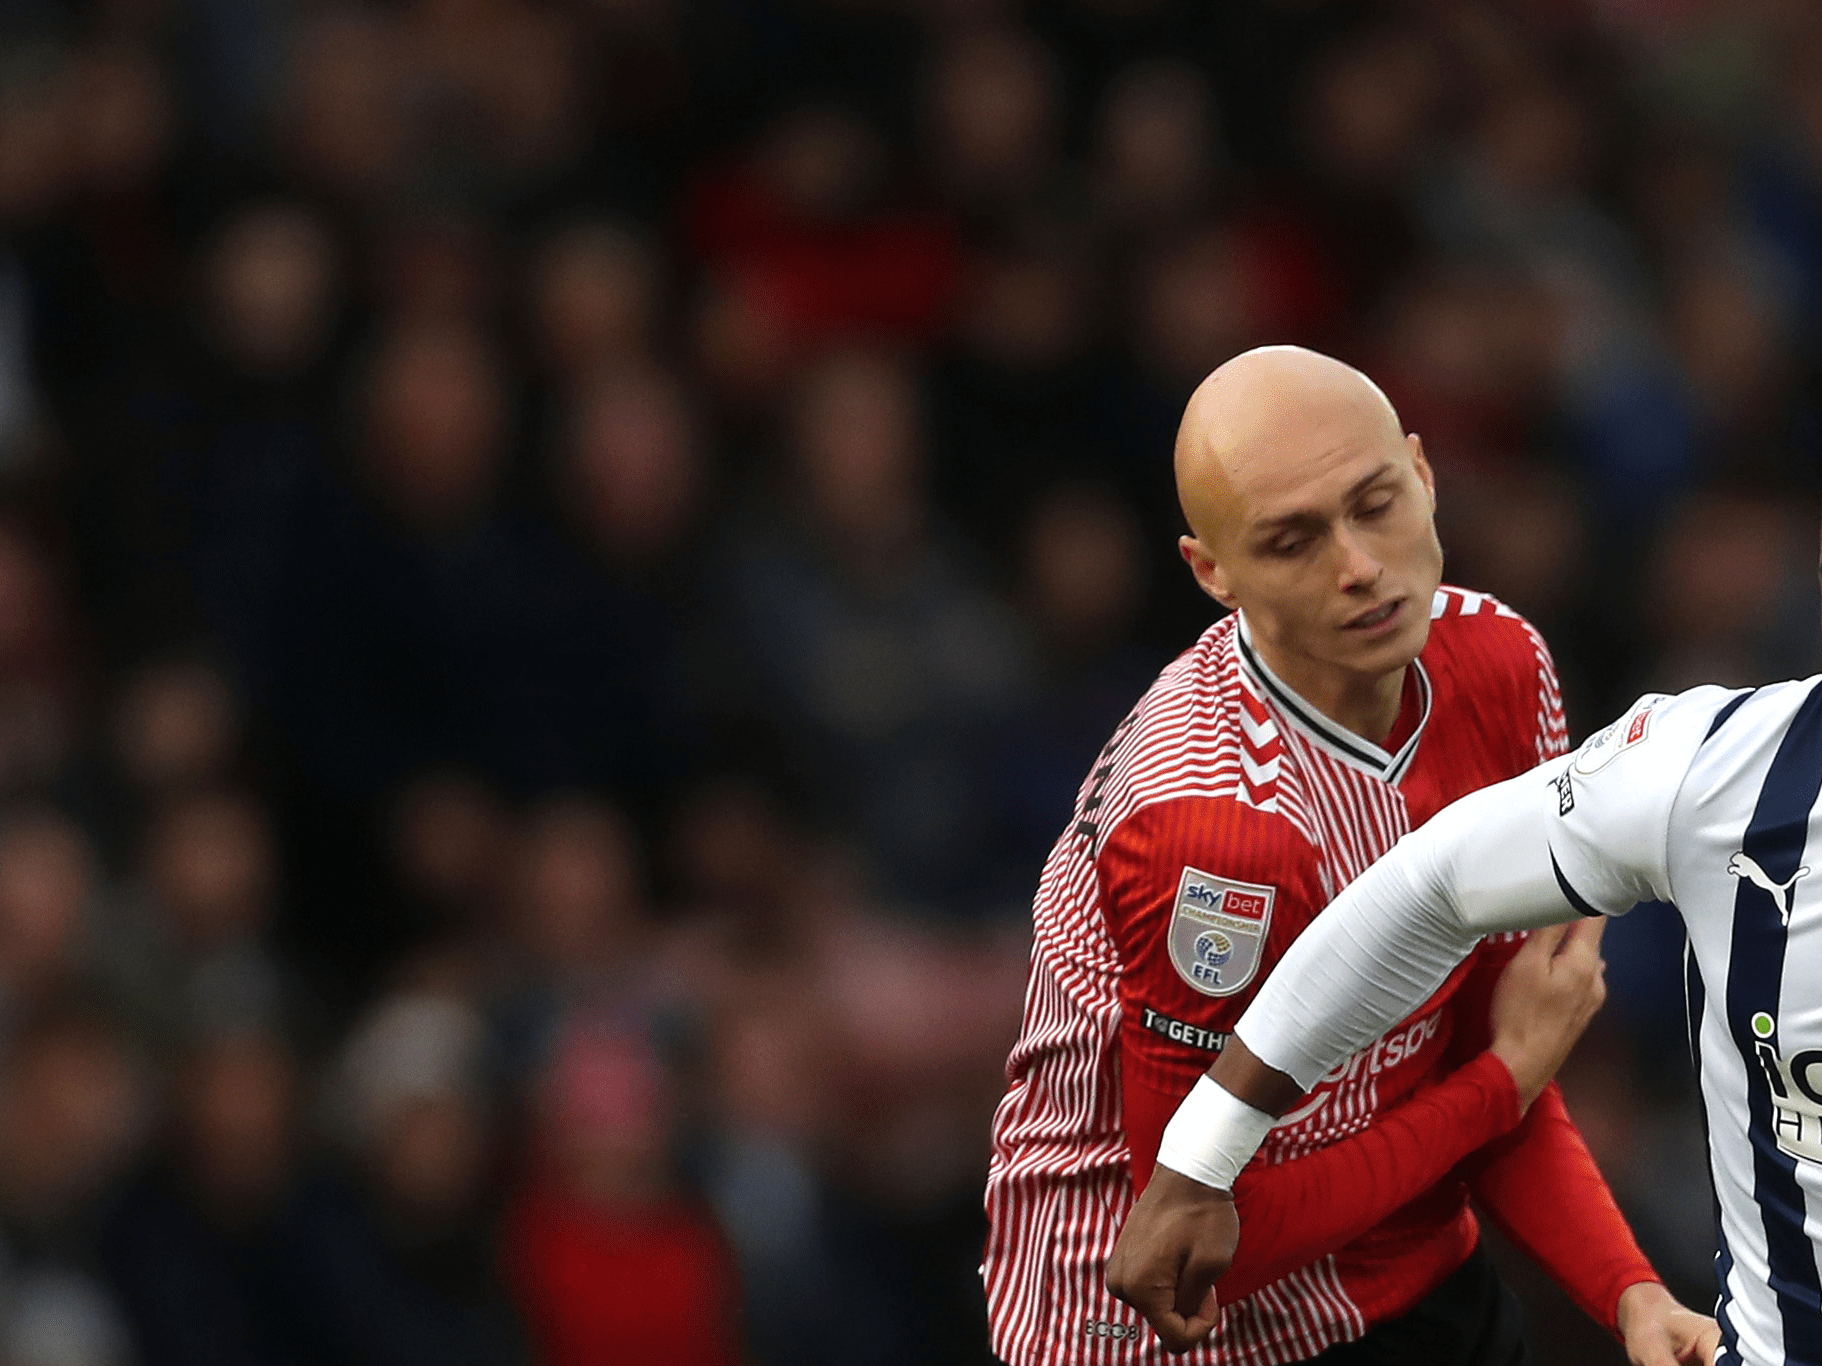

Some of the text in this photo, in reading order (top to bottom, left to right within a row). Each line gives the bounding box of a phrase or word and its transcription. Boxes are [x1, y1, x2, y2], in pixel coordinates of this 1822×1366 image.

[1185, 885, 1261, 914] sky bet
[1193, 964, 1221, 985] EFL
